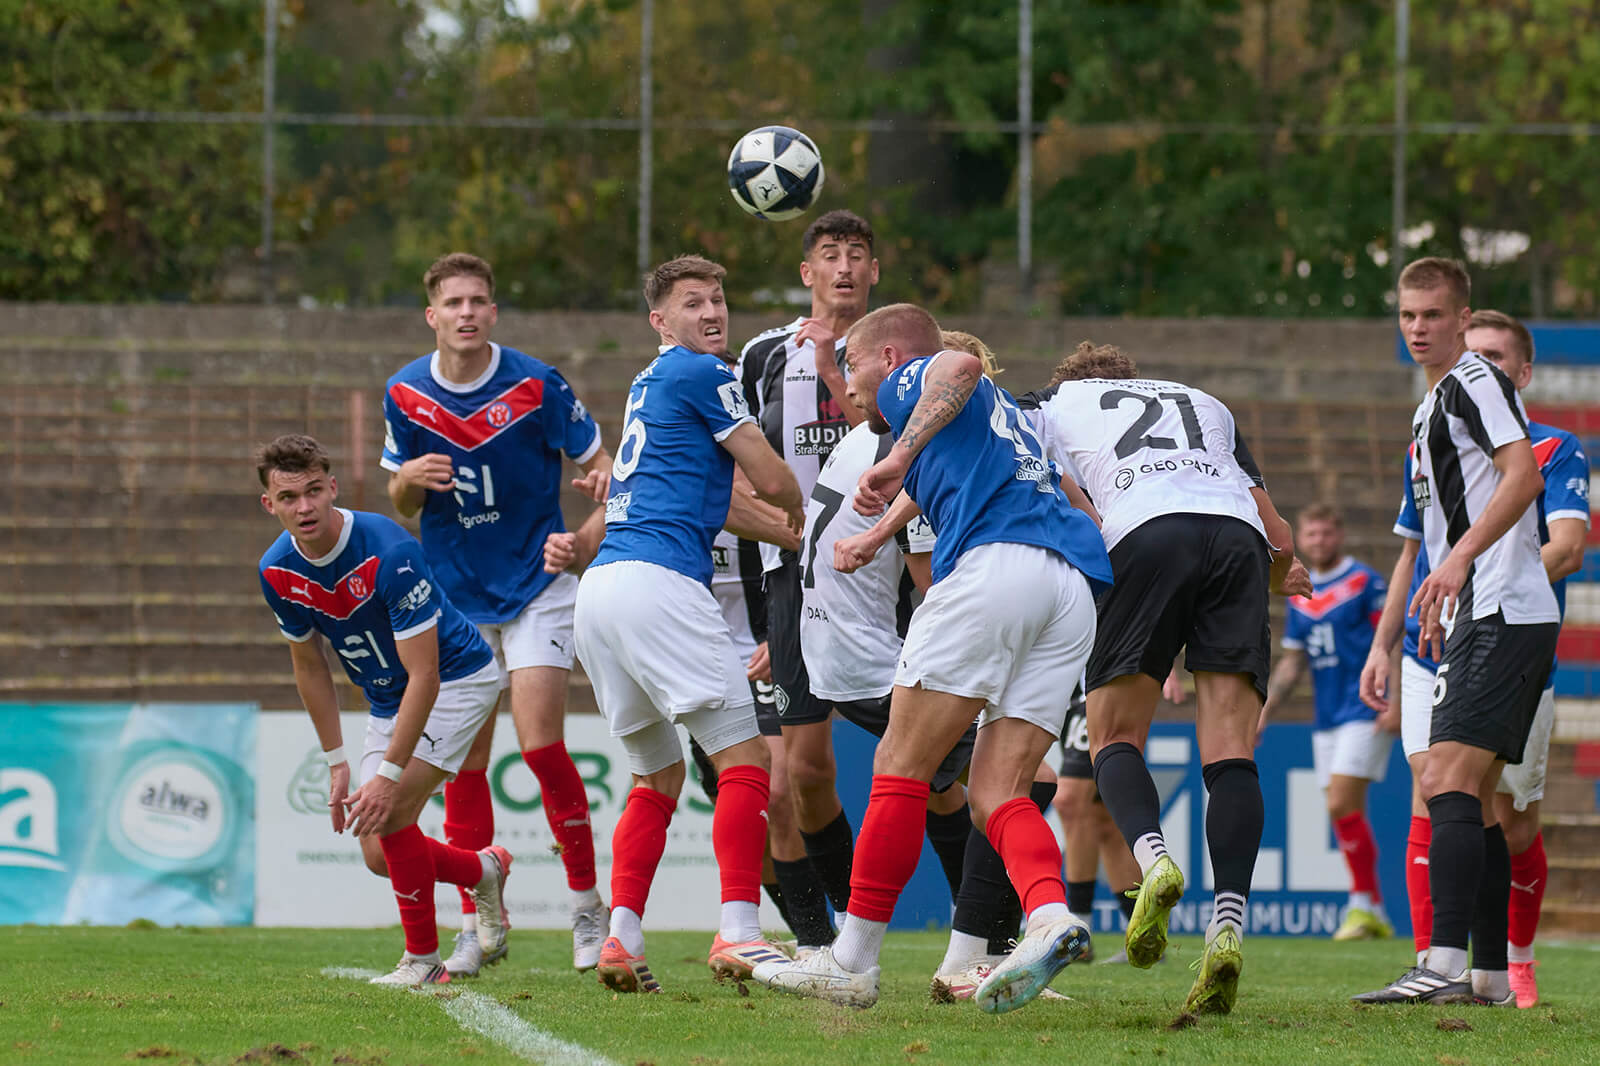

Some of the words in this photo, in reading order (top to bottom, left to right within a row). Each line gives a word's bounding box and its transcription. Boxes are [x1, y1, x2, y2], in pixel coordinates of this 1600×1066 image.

[1099, 389, 1208, 460] 21
[1139, 459, 1178, 474] GEO
[1181, 458, 1222, 479] DATA
[799, 482, 845, 588] 7
[808, 607, 829, 623] DATA
[1064, 715, 1089, 751] 16
[139, 780, 210, 820] alwa
